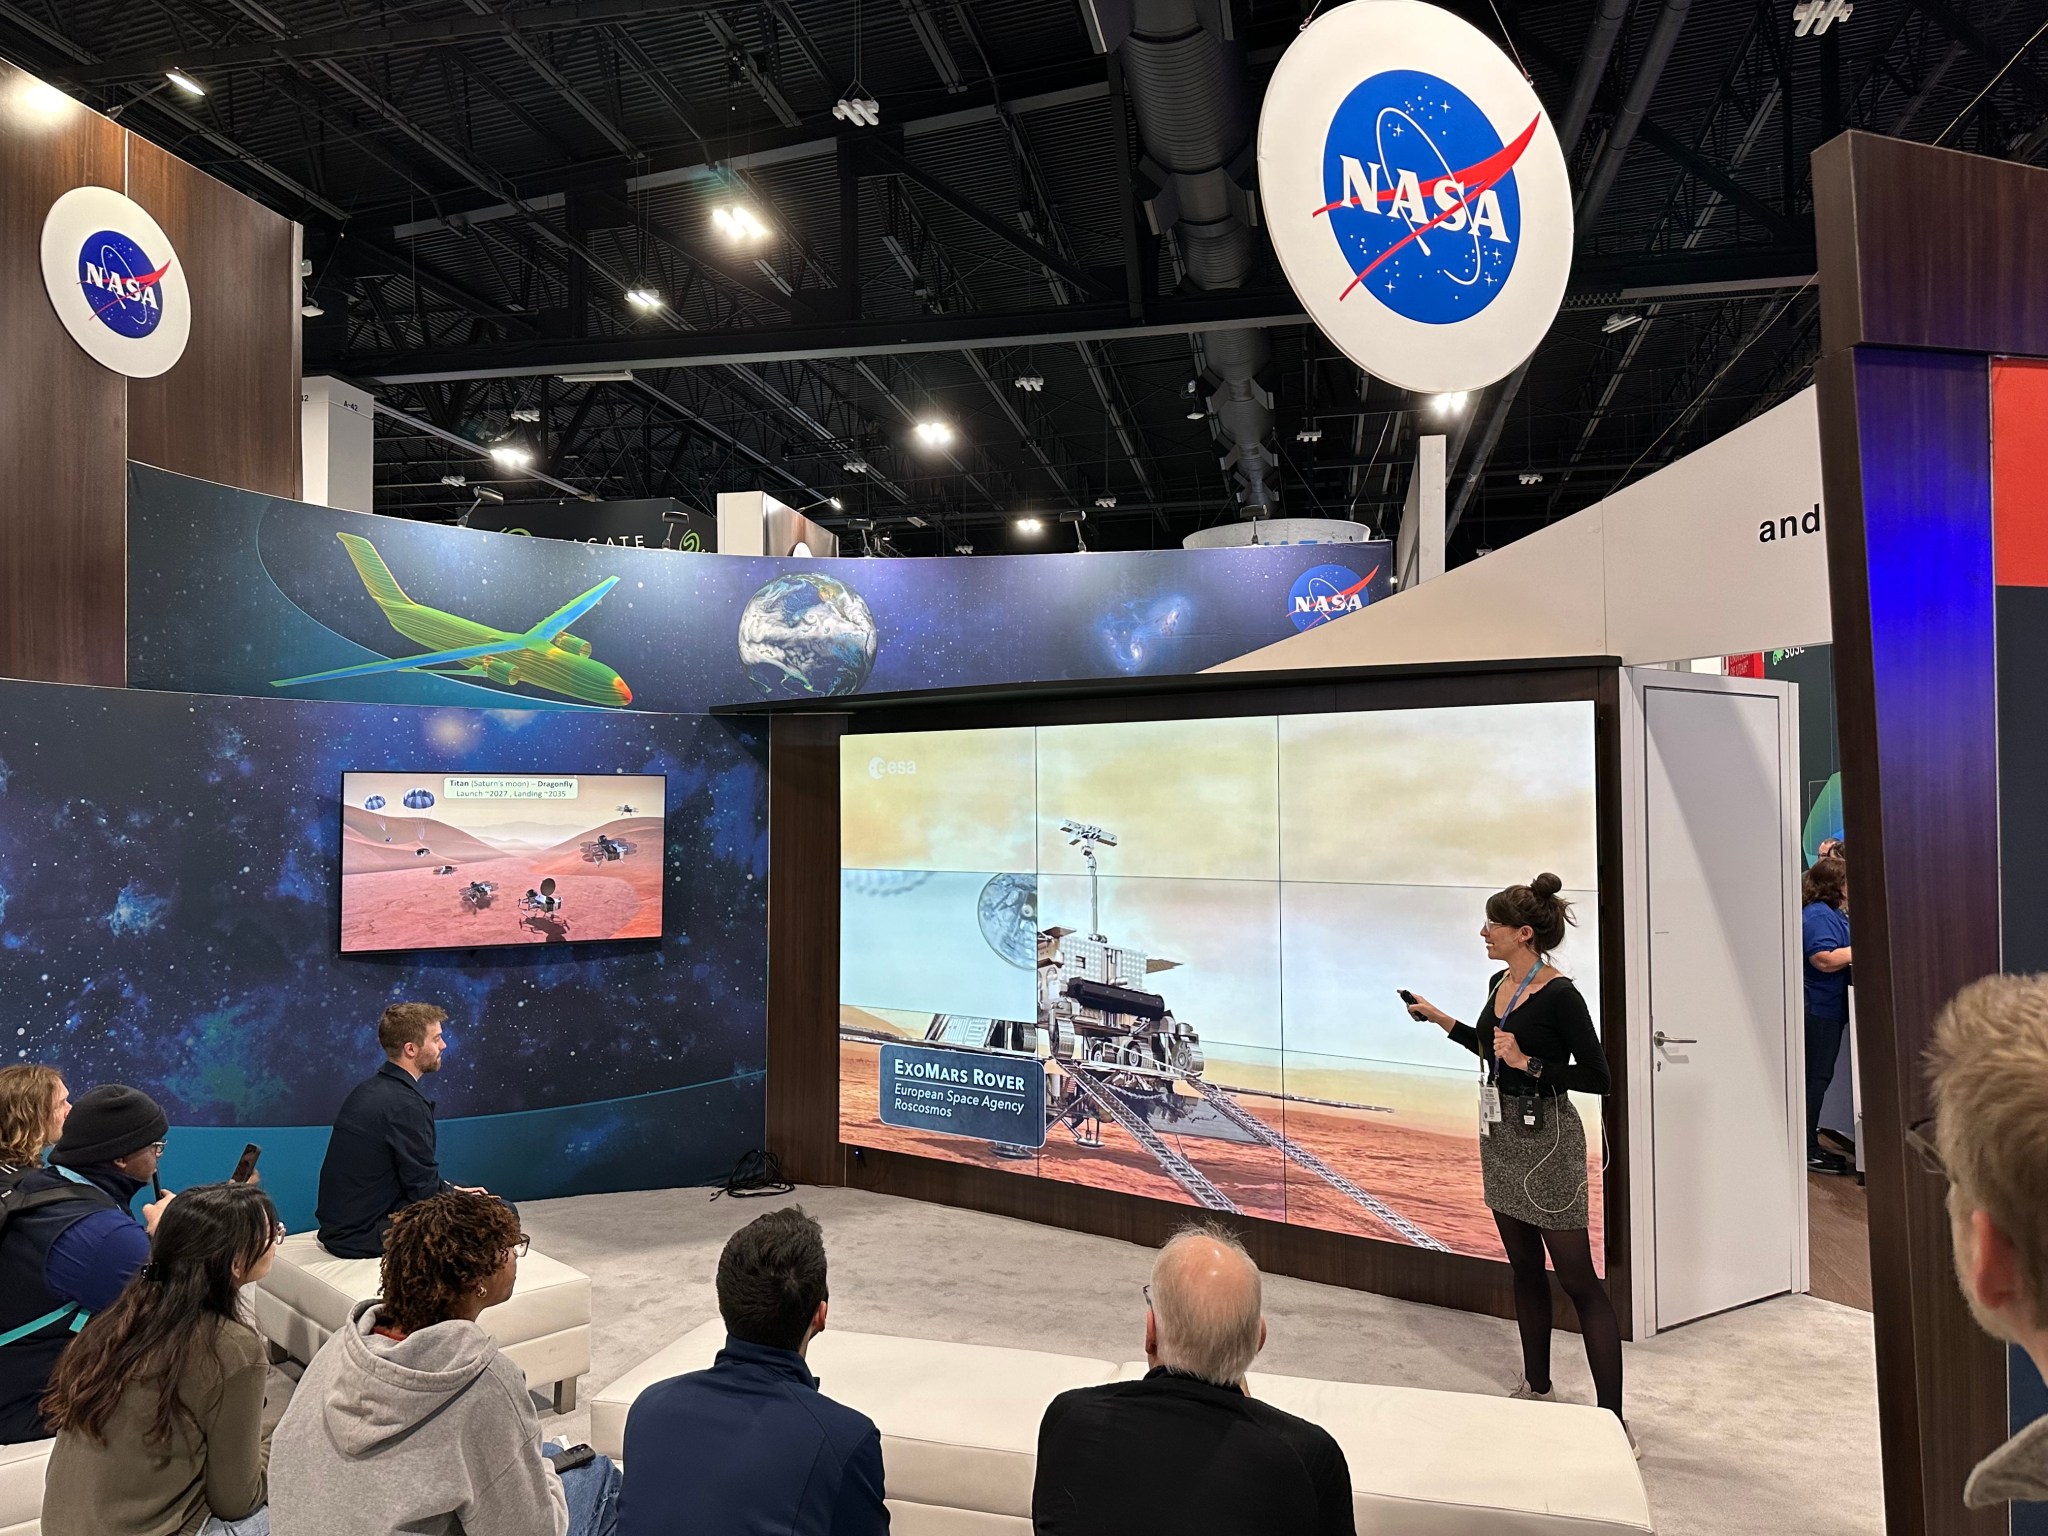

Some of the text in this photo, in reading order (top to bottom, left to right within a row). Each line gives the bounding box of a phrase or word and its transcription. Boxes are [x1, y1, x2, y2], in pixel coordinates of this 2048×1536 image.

[1339, 154, 1512, 244] NASA
[85, 261, 160, 311] NASA
[343, 400, 358, 411] A-42
[1759, 502, 1821, 543] and
[1294, 593, 1363, 613] NASA
[450, 779, 469, 787] Titan
[471, 779, 504, 788] (Saturn's
[505, 779, 530, 788] moon)
[537, 780, 573, 789] Dragonfly
[514, 790, 542, 799] Landing
[894, 1082, 1025, 1115] European Space Agency
[894, 1097, 953, 1118] Roscosmos
